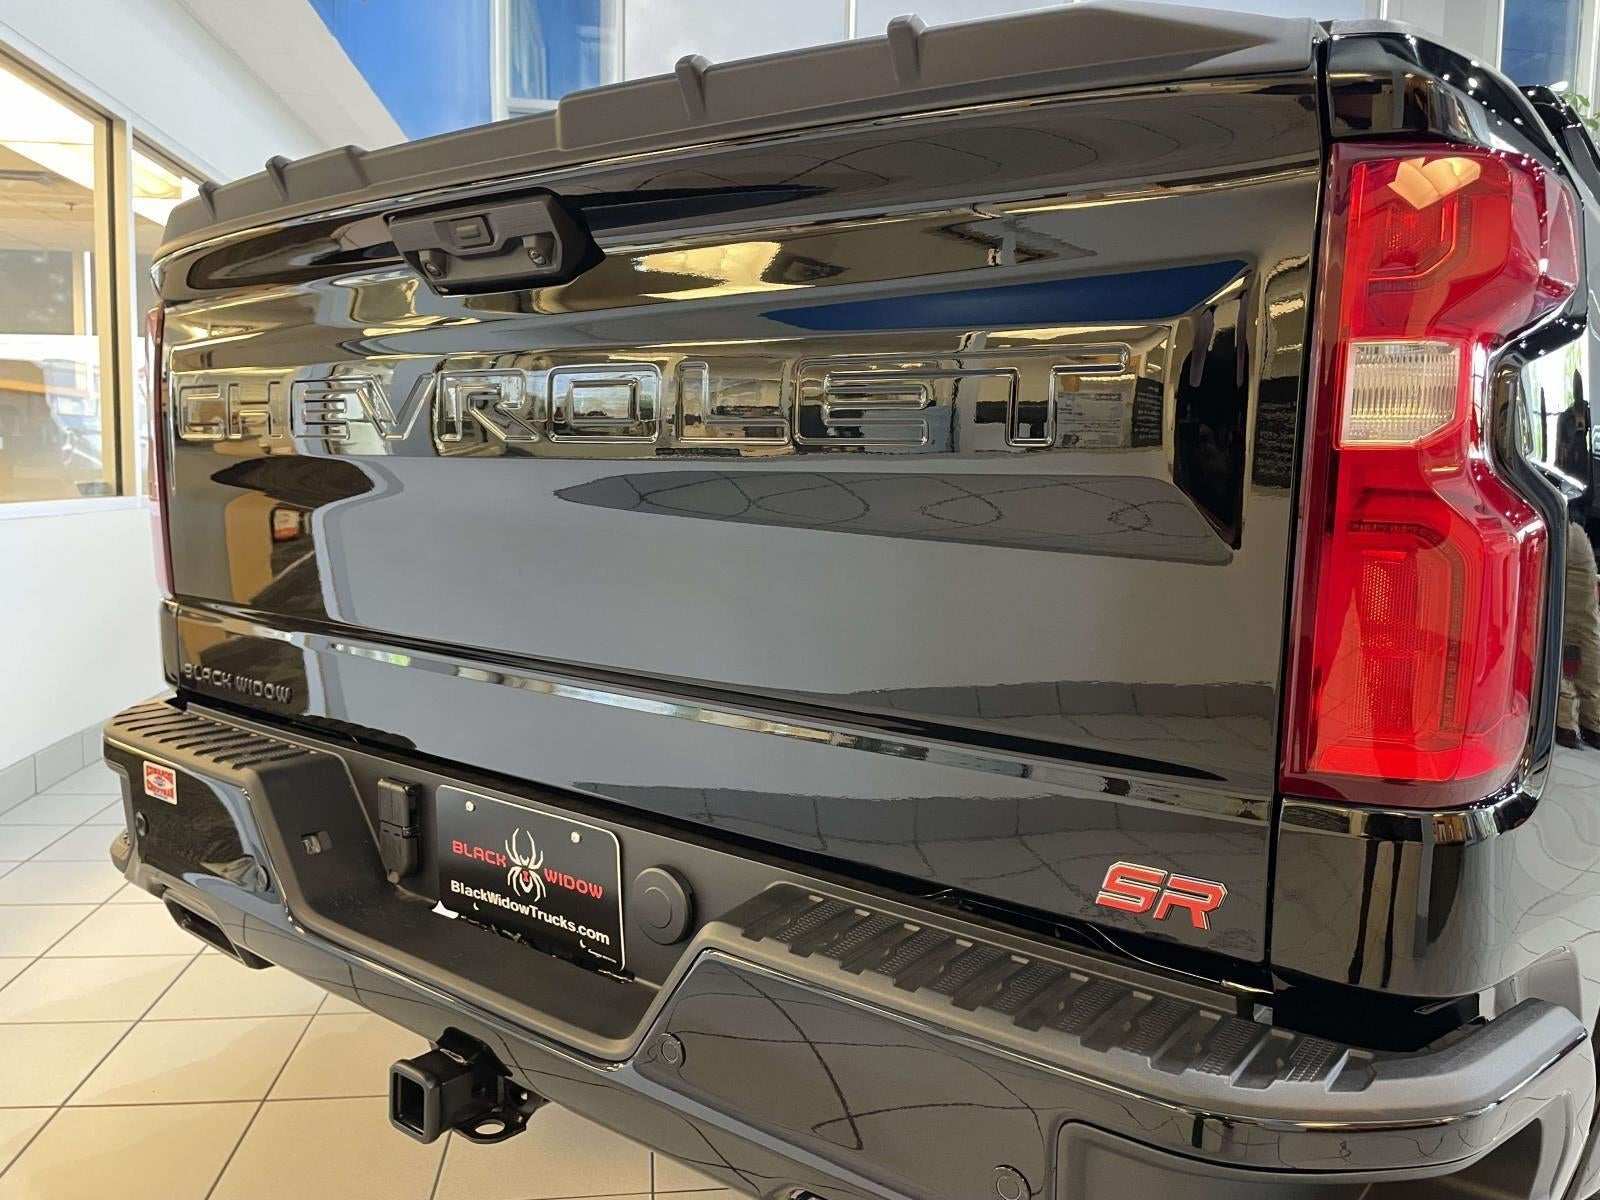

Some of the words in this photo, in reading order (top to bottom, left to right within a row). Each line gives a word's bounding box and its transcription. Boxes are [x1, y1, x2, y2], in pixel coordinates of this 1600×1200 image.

[177, 342, 1130, 448] CHEVROLET
[183, 663, 234, 688] BLACK
[234, 675, 293, 704] WIDOW
[452, 840, 507, 868] BLACK
[543, 868, 604, 899] WIDOW
[1095, 861, 1228, 931] SR
[450, 879, 610, 945] BlackWidowTrucks.com
